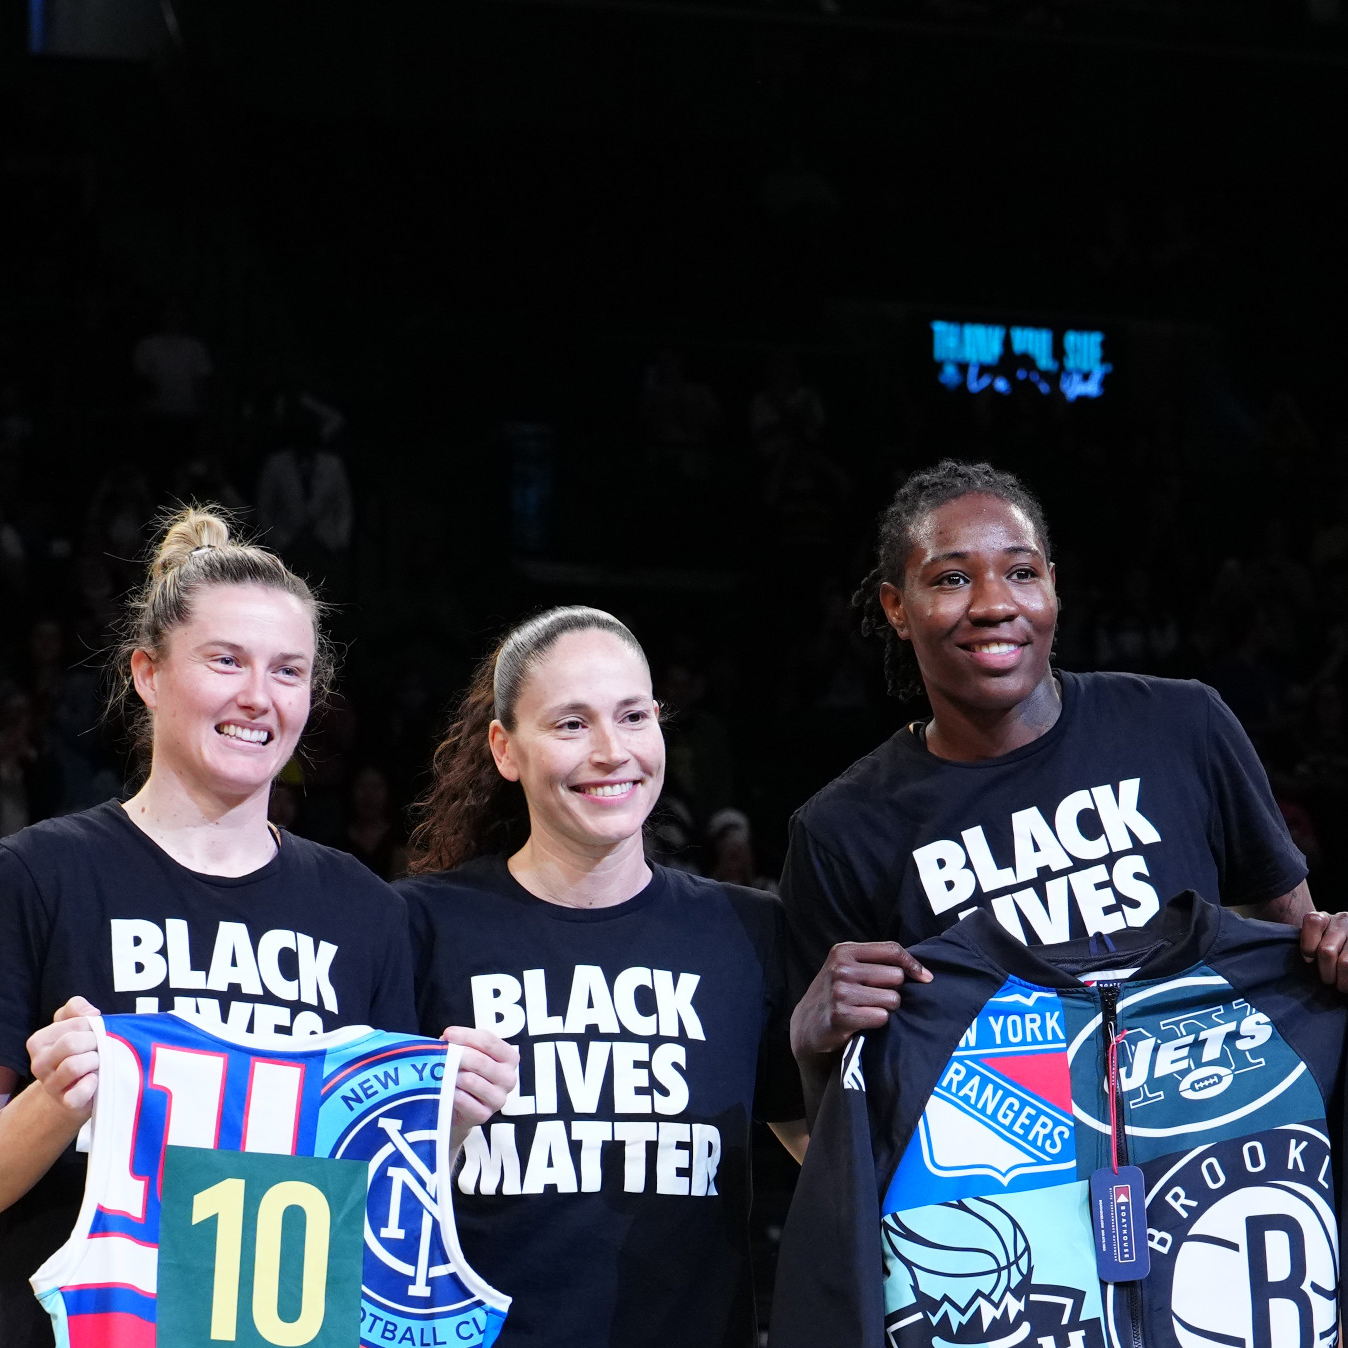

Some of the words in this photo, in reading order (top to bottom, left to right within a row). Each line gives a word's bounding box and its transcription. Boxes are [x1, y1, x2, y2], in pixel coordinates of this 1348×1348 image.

[912, 778, 1161, 915] BLACK
[963, 855, 1160, 945] IVES
[111, 919, 338, 1014] BLACK
[471, 965, 706, 1041] BLACK
[988, 1011, 1066, 1045] YORK
[1105, 1011, 1273, 1093] JETS
[340, 1066, 400, 1112] NEW
[501, 1041, 689, 1115] LIVES
[941, 1061, 1070, 1154] RANGERS
[458, 1120, 719, 1196] MATTER
[191, 1177, 331, 1347] 10
[1120, 1205, 1130, 1259] BOATHOUSE
